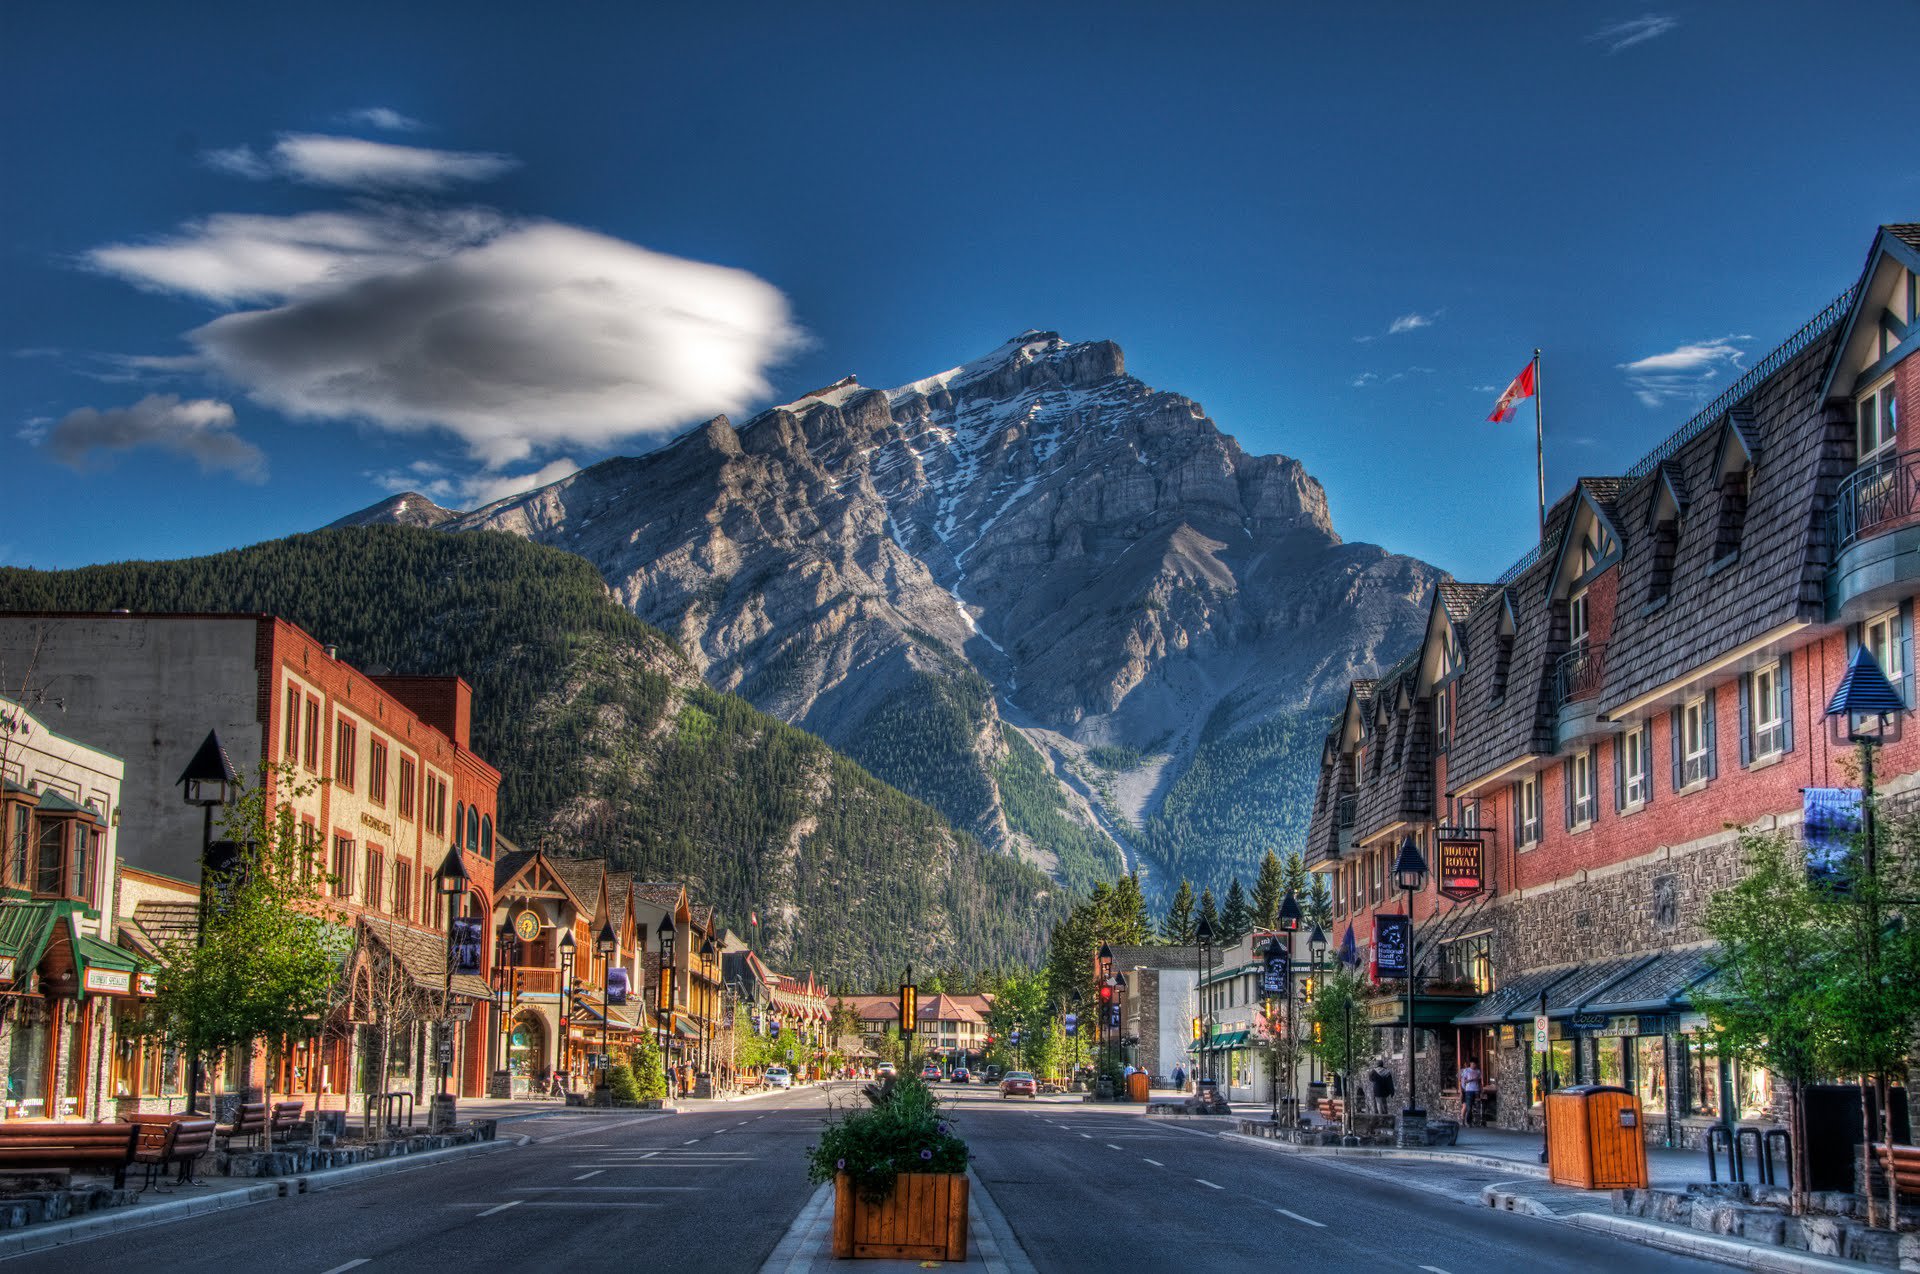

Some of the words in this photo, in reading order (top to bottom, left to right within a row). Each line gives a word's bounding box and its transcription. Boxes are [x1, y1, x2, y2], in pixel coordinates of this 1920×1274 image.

[1444, 846, 1479, 857] MOUNT
[1445, 857, 1478, 867] ROYAL
[1445, 868, 1478, 876] HOTEL
